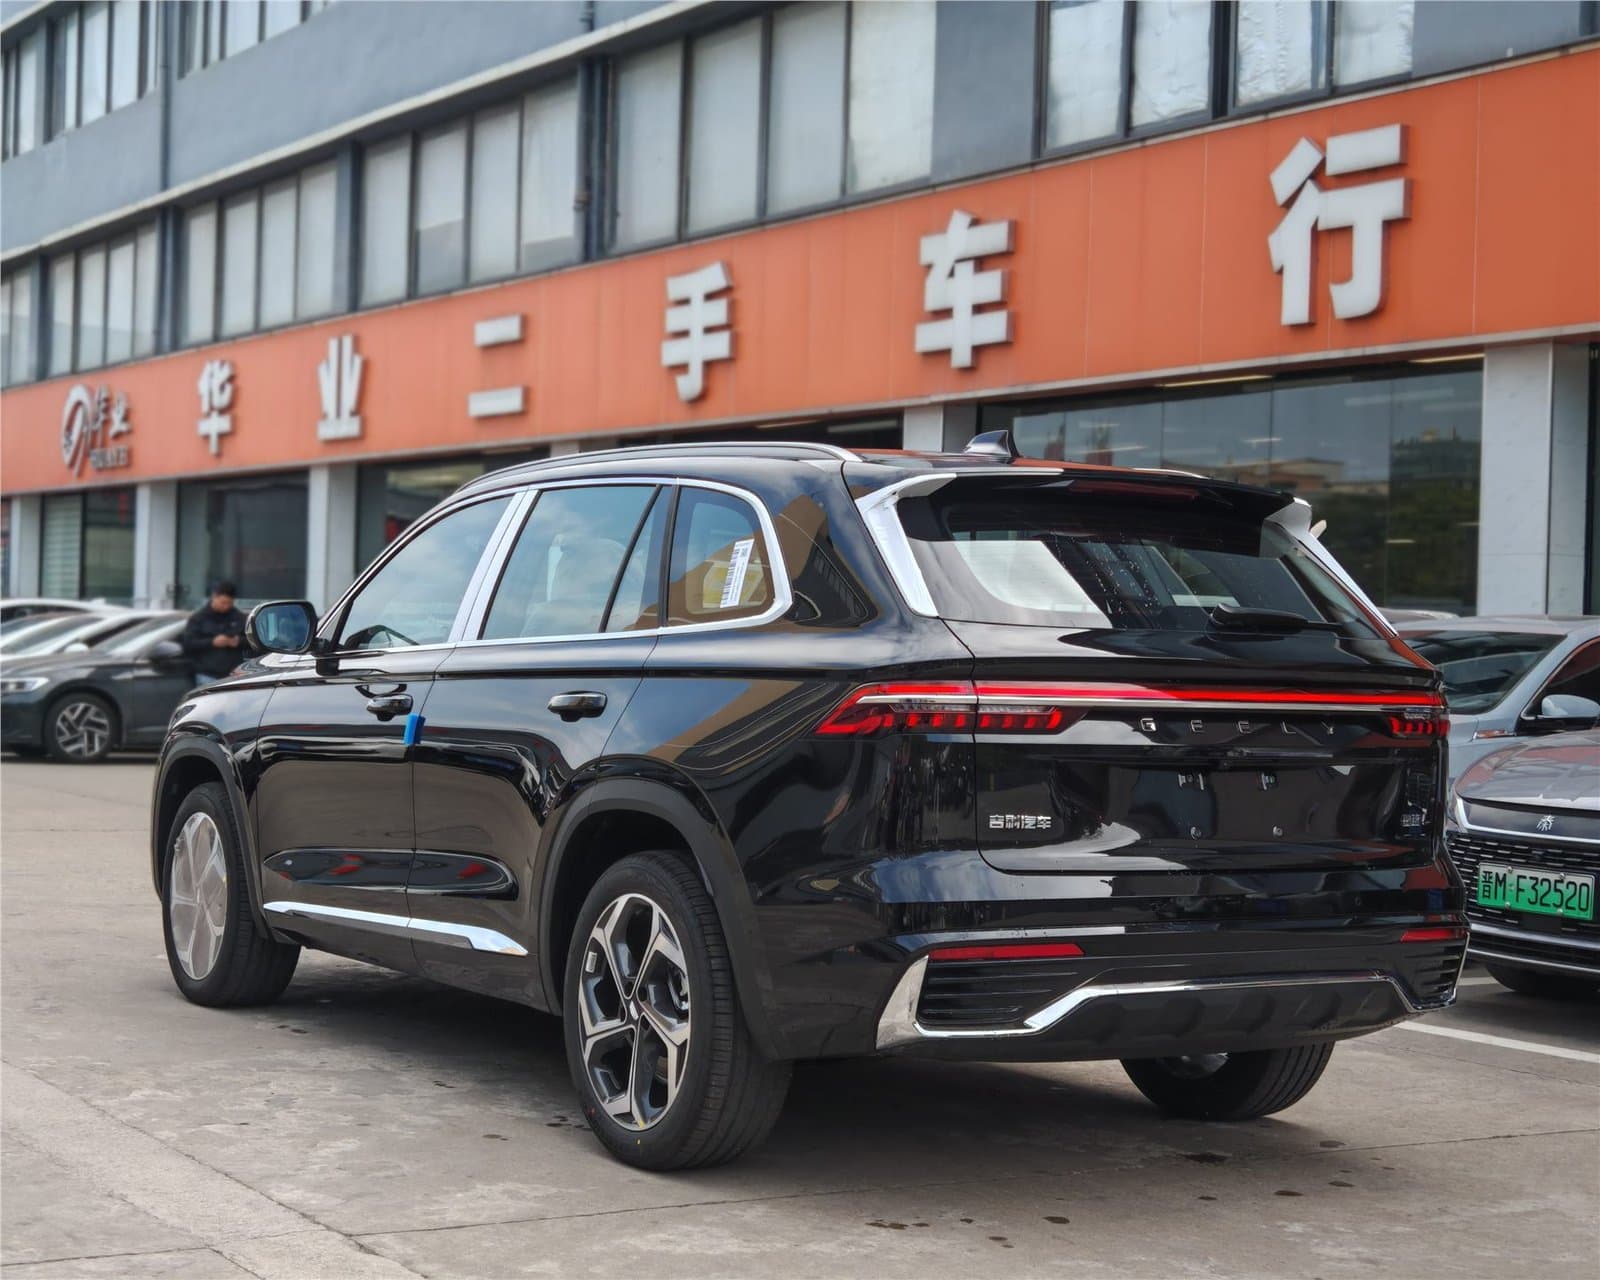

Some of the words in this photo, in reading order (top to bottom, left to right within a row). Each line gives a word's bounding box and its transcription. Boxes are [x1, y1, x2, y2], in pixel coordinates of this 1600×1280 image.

[196, 123, 1411, 455] 华业二手车行
[1139, 717, 1336, 735] GEELY
[989, 814, 1052, 830] 吉利汽车
